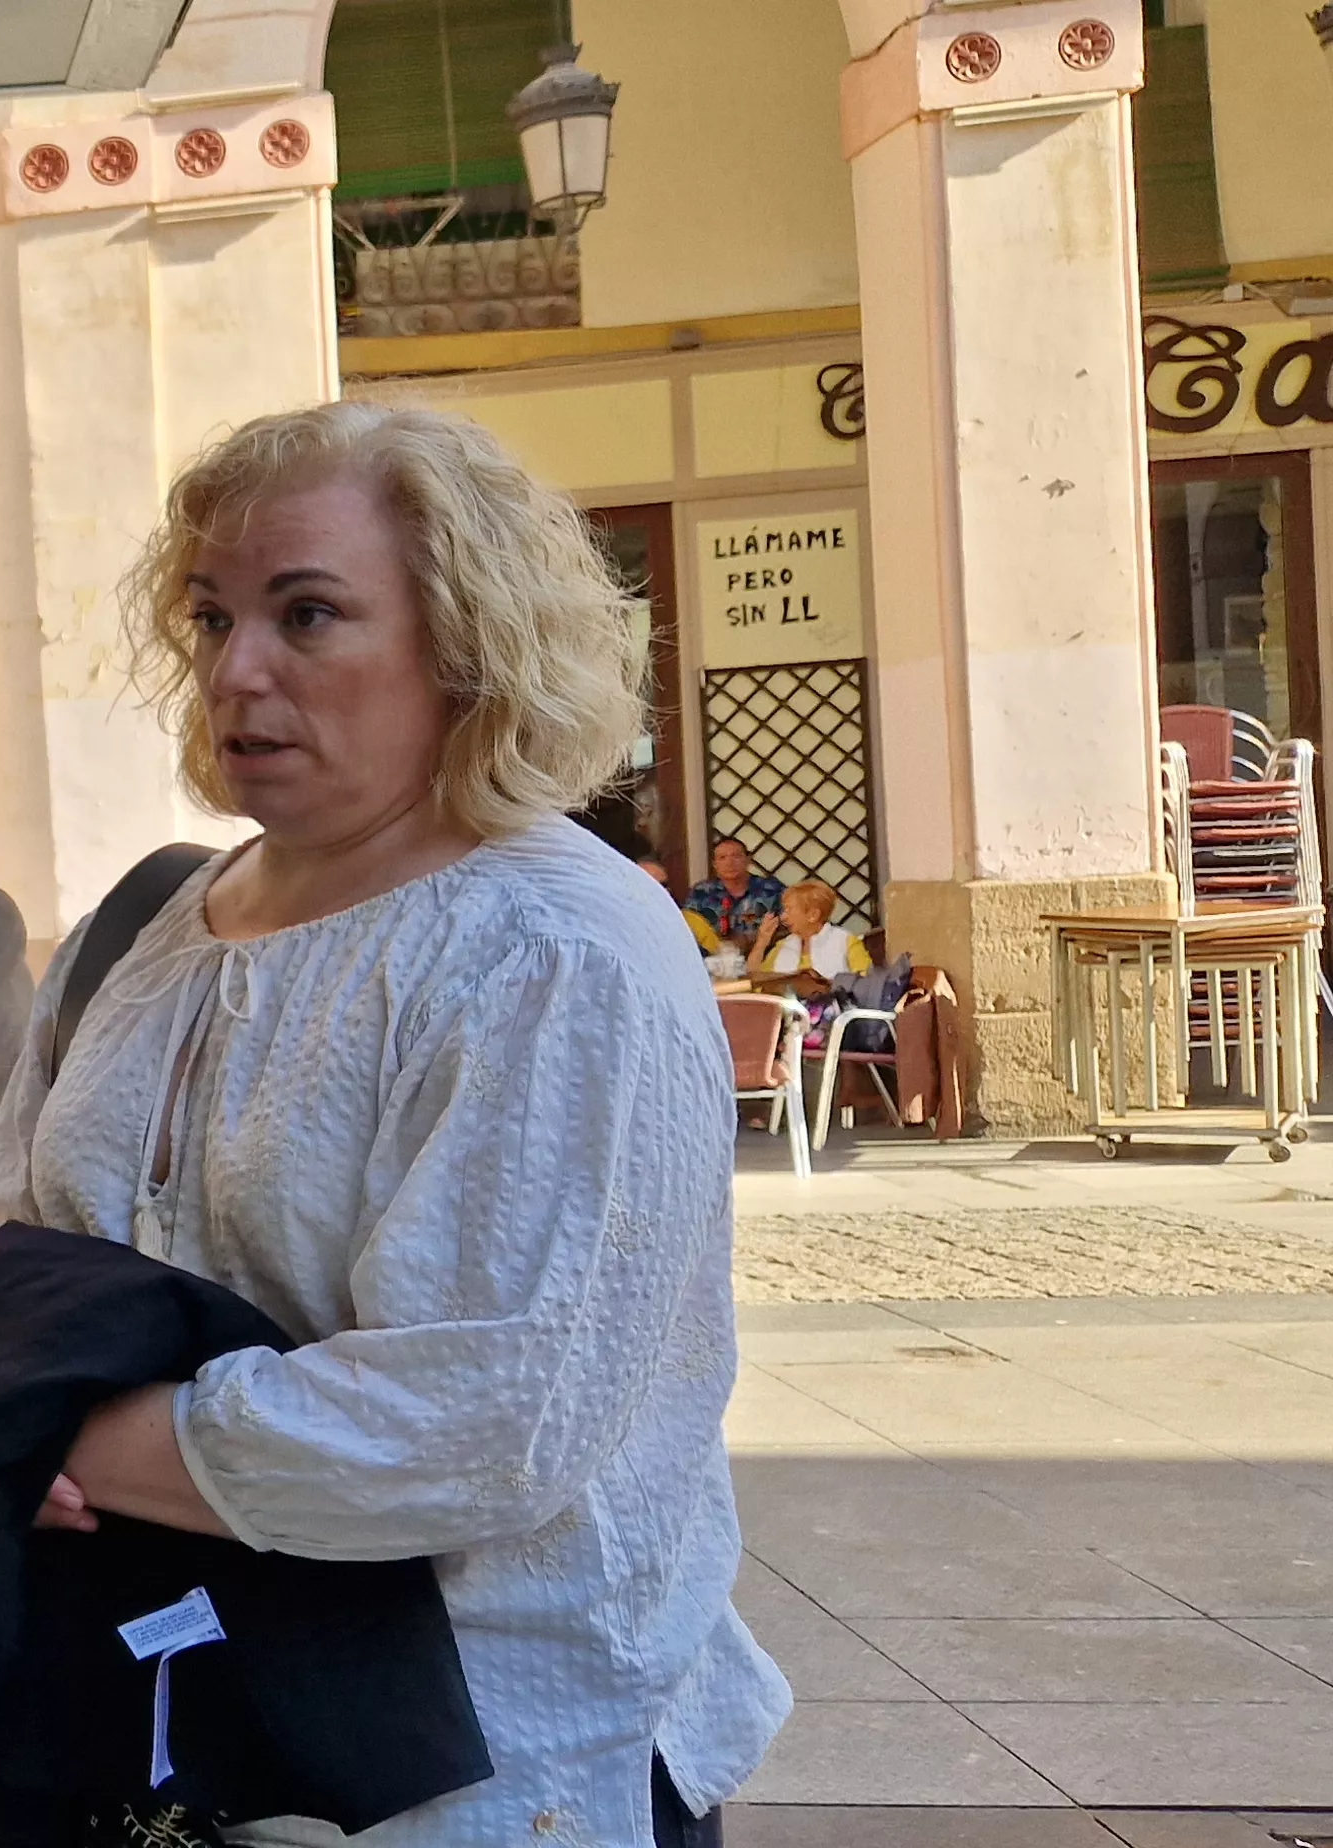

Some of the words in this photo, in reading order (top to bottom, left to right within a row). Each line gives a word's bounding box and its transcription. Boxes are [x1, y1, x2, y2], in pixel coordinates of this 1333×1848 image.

[714, 523, 846, 560] LLÁMAME
[727, 567, 793, 590] PERO
[726, 603, 766, 627] SIN
[779, 595, 820, 625] LL
